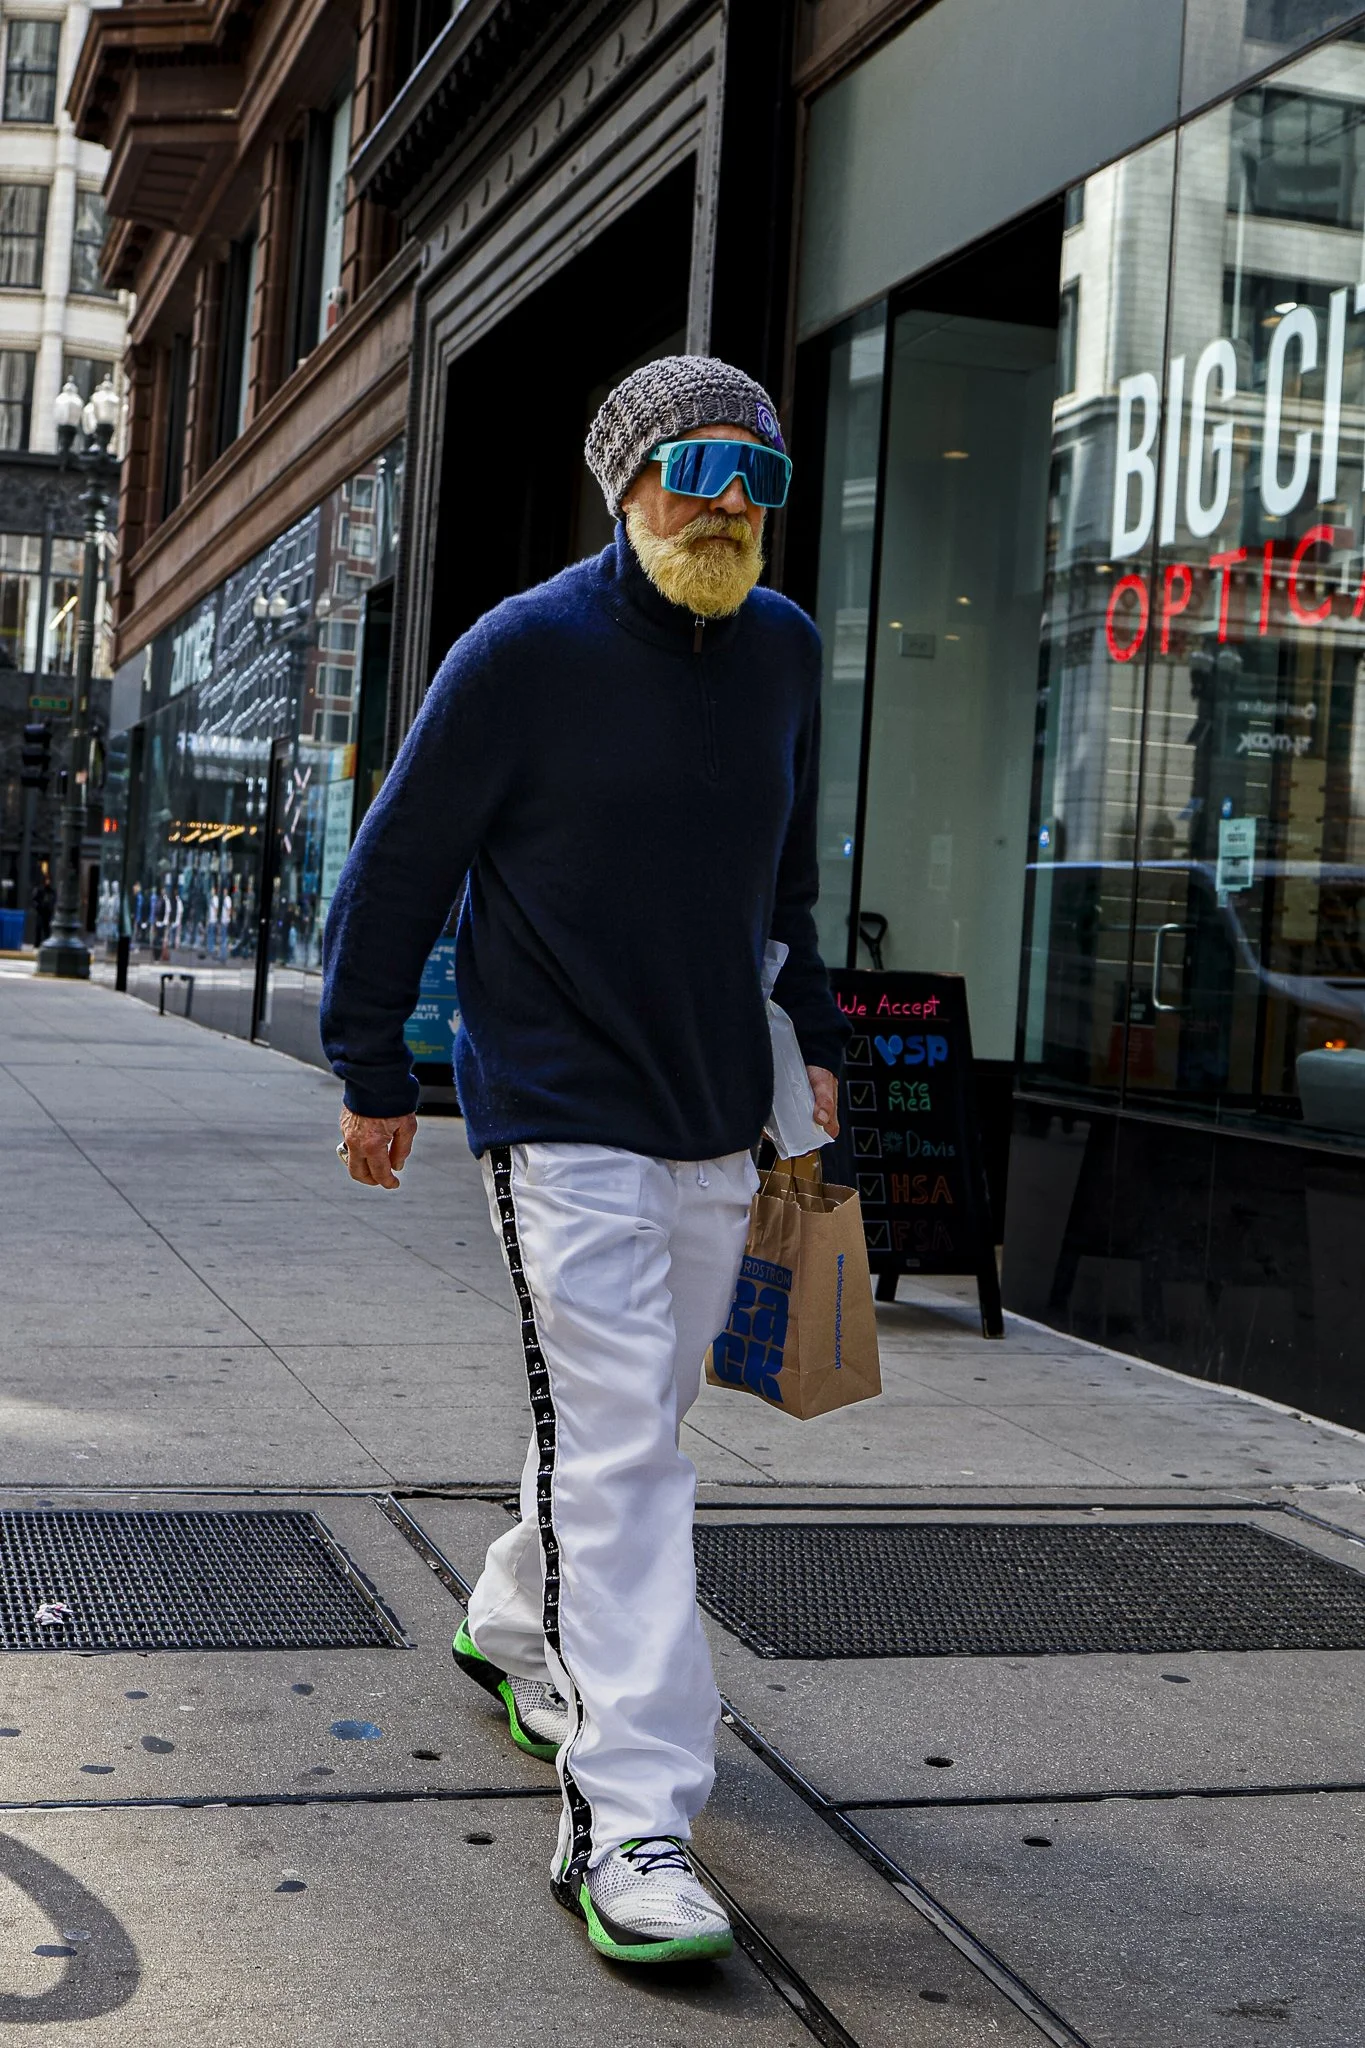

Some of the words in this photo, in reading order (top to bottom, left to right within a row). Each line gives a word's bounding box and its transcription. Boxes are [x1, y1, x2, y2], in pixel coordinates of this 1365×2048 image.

[1110, 338, 1238, 561] BIG
[1261, 282, 1365, 517] CI
[836, 992, 867, 1016] We
[875, 993, 941, 1020] Accept
[888, 1095, 932, 1112] Med
[905, 1130, 957, 1158] Davis
[889, 1172, 956, 1205] HSA
[893, 1218, 955, 1252] FSA
[743, 1259, 791, 1289] RDSTROM
